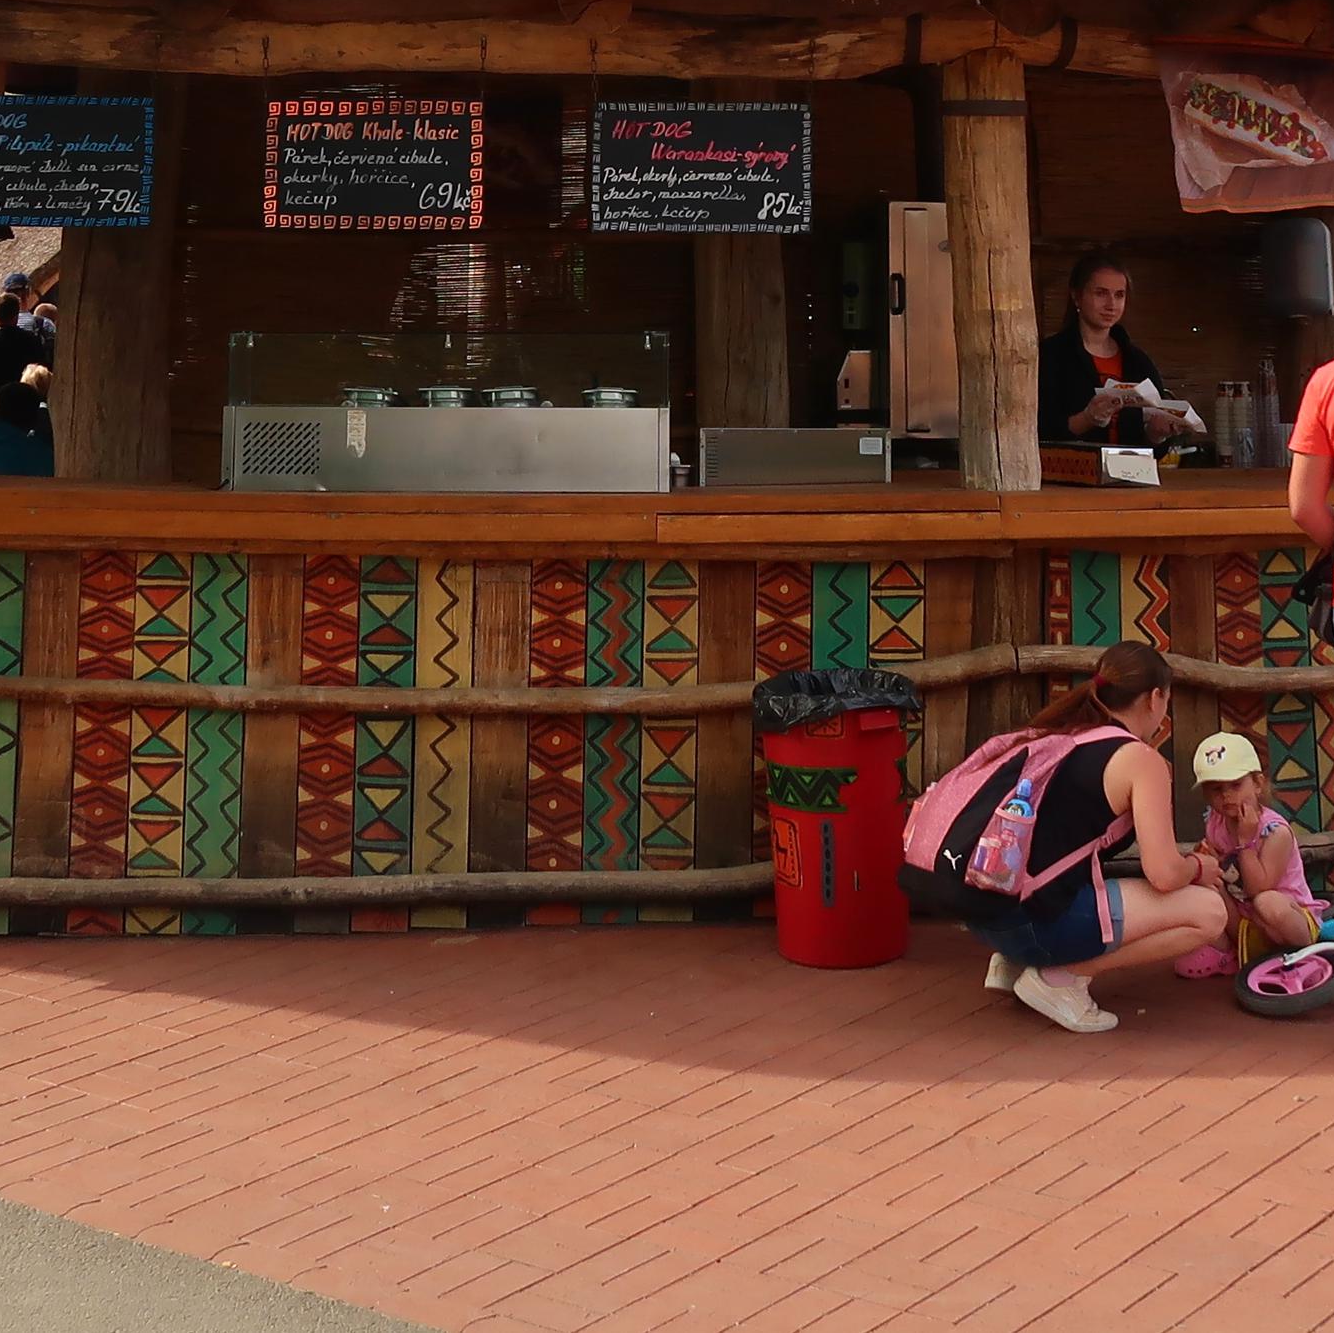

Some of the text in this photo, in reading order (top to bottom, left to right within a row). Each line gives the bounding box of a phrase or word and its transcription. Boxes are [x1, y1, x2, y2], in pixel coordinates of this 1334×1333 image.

[286, 123, 323, 143] HOT
[321, 122, 355, 140] DOG
[612, 119, 692, 139] HOT DOG
[284, 191, 338, 210] kečup
